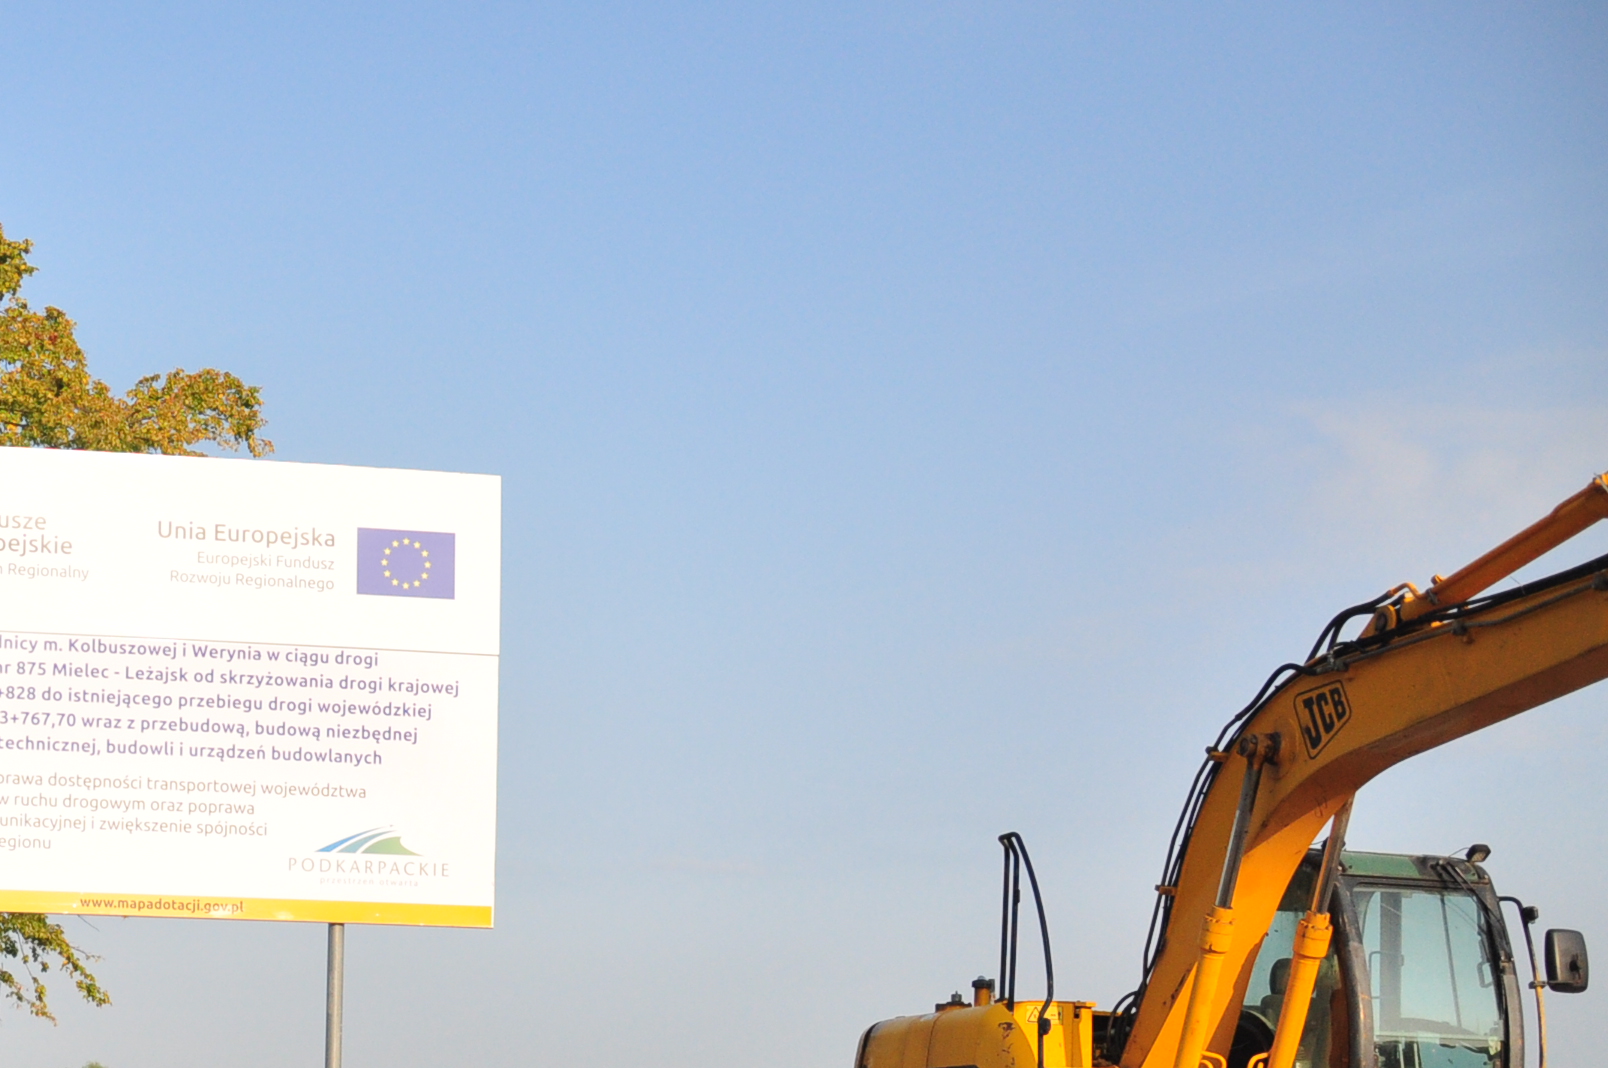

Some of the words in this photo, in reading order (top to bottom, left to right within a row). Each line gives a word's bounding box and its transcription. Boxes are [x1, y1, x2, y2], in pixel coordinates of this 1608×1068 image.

[158, 520, 206, 541] Unia
[214, 523, 335, 550] Europejska
[7, 562, 90, 582] Regionalny
[197, 550, 272, 569] Europejski
[276, 554, 335, 571] Fundusz
[169, 569, 231, 588] Rozwoju
[235, 572, 335, 593] Regionalnego
[44, 640, 62, 652] m.
[68, 638, 177, 660] Kolbuszowej
[182, 642, 187, 657] i
[192, 641, 262, 663] Werynia
[265, 647, 282, 661] w
[285, 644, 330, 670] ciągu
[333, 647, 380, 671] drogi
[16, 661, 47, 676] 875
[52, 662, 109, 679] Mielec
[125, 665, 188, 685] Leżajsk
[193, 668, 215, 684] od
[219, 669, 334, 689] skrzyżowania
[338, 674, 383, 694] drogi
[388, 676, 459, 698] krajowej
[41, 686, 63, 702] do
[68, 687, 173, 709] istniejącego
[178, 693, 263, 713] przebiegu
[268, 696, 313, 716] drogi
[317, 699, 432, 722] wojewódzkiej
[81, 716, 122, 729] wraz
[126, 718, 136, 730] z
[140, 716, 250, 739] przebudową,
[255, 720, 321, 742] budową
[326, 723, 418, 745] niezbędnej
[1301, 686, 1347, 750] JCB
[106, 738, 174, 756] budowli
[179, 741, 184, 757] i
[189, 743, 266, 762] urządzeń
[271, 745, 382, 767] budowlanych
[47, 771, 143, 791] dostępności
[146, 776, 257, 798] transportowej
[260, 781, 367, 799] województwa
[14, 792, 58, 808] ruchu
[62, 793, 146, 813] drogowym
[150, 800, 184, 813] oraz
[187, 801, 255, 816] poprawa
[91, 815, 95, 830] i
[99, 817, 193, 835] zwiększenie
[196, 820, 268, 838] spójności
[288, 857, 450, 878] PODKARPACKIE
[379, 878, 419, 887] otwarta
[79, 896, 245, 915] www.mapadotacji.gov.pl
